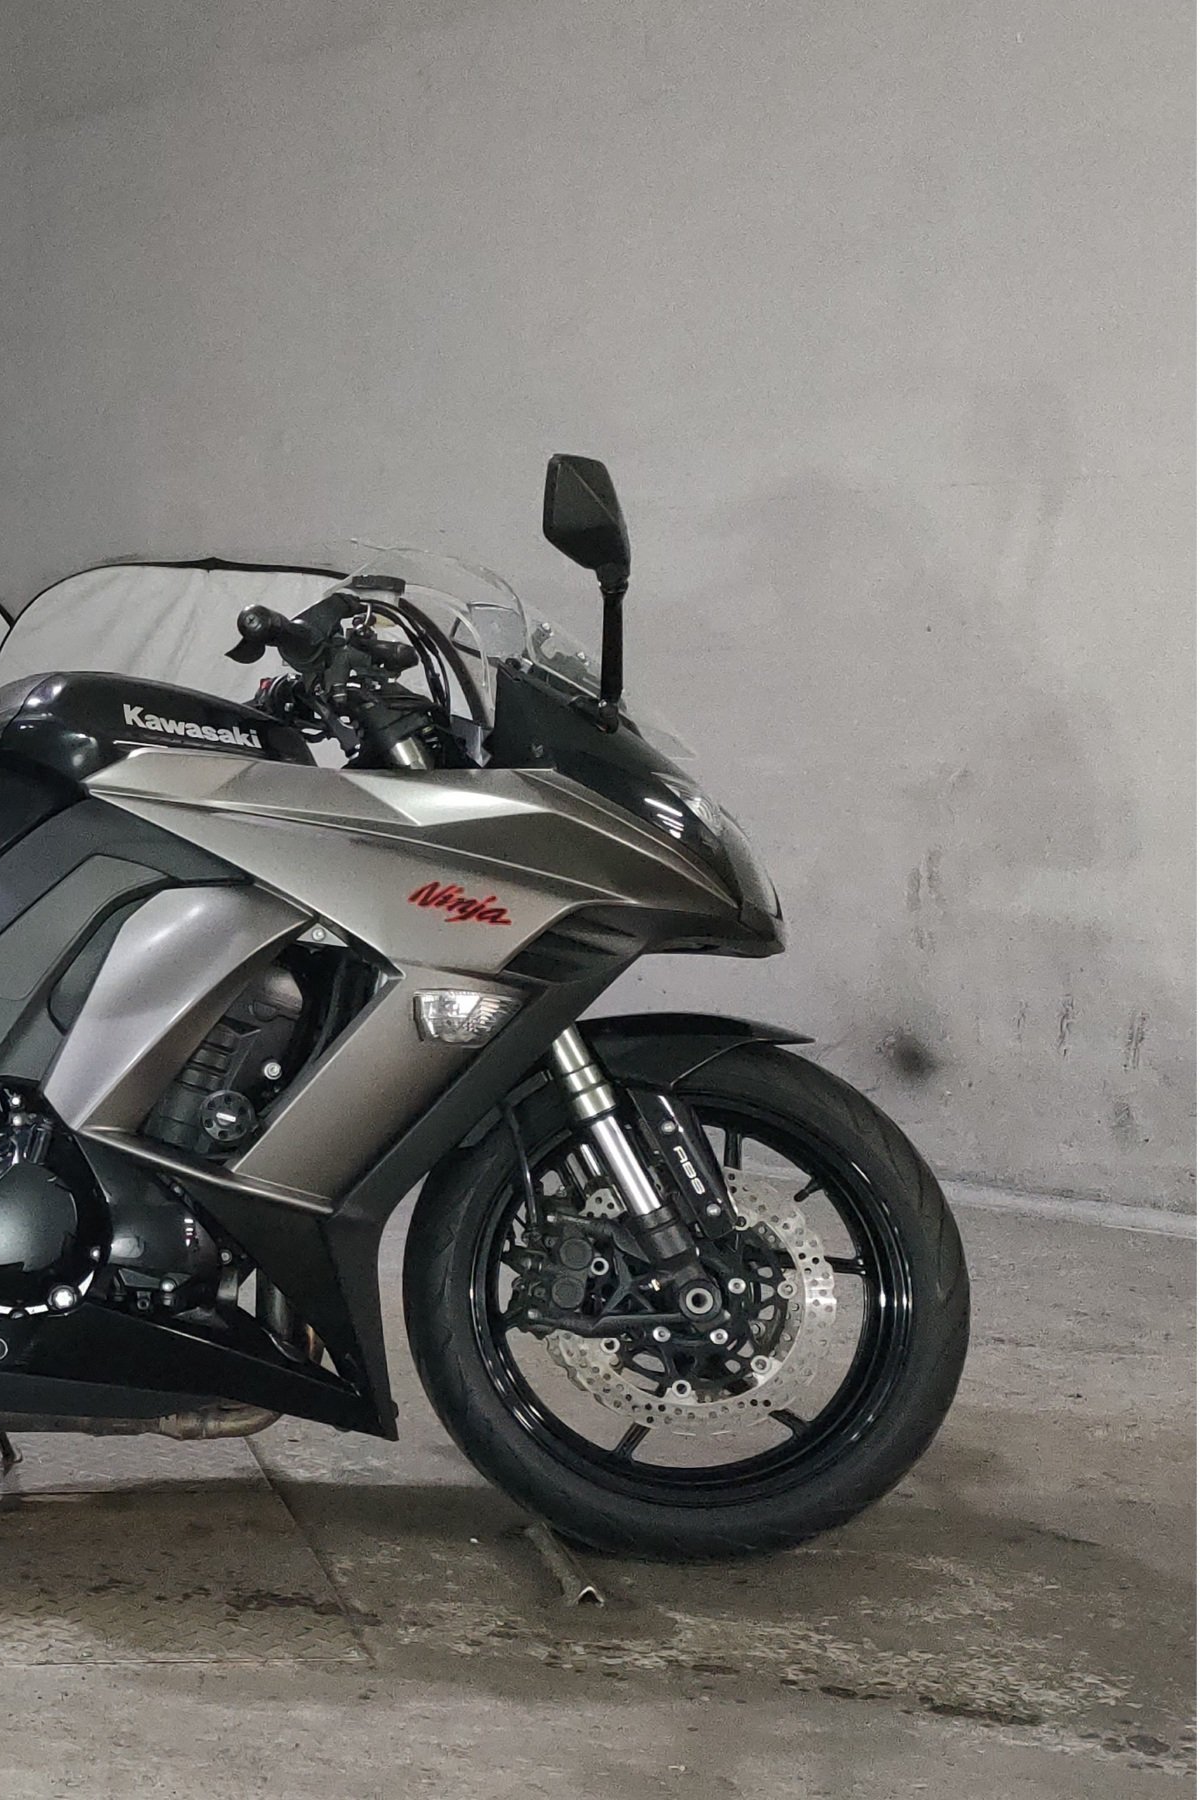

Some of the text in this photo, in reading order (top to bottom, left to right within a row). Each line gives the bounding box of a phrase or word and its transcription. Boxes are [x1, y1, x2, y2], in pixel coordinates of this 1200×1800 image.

[122, 703, 262, 749] Kawasaki
[408, 881, 512, 926] Ninja
[673, 1145, 706, 1195] ABS
